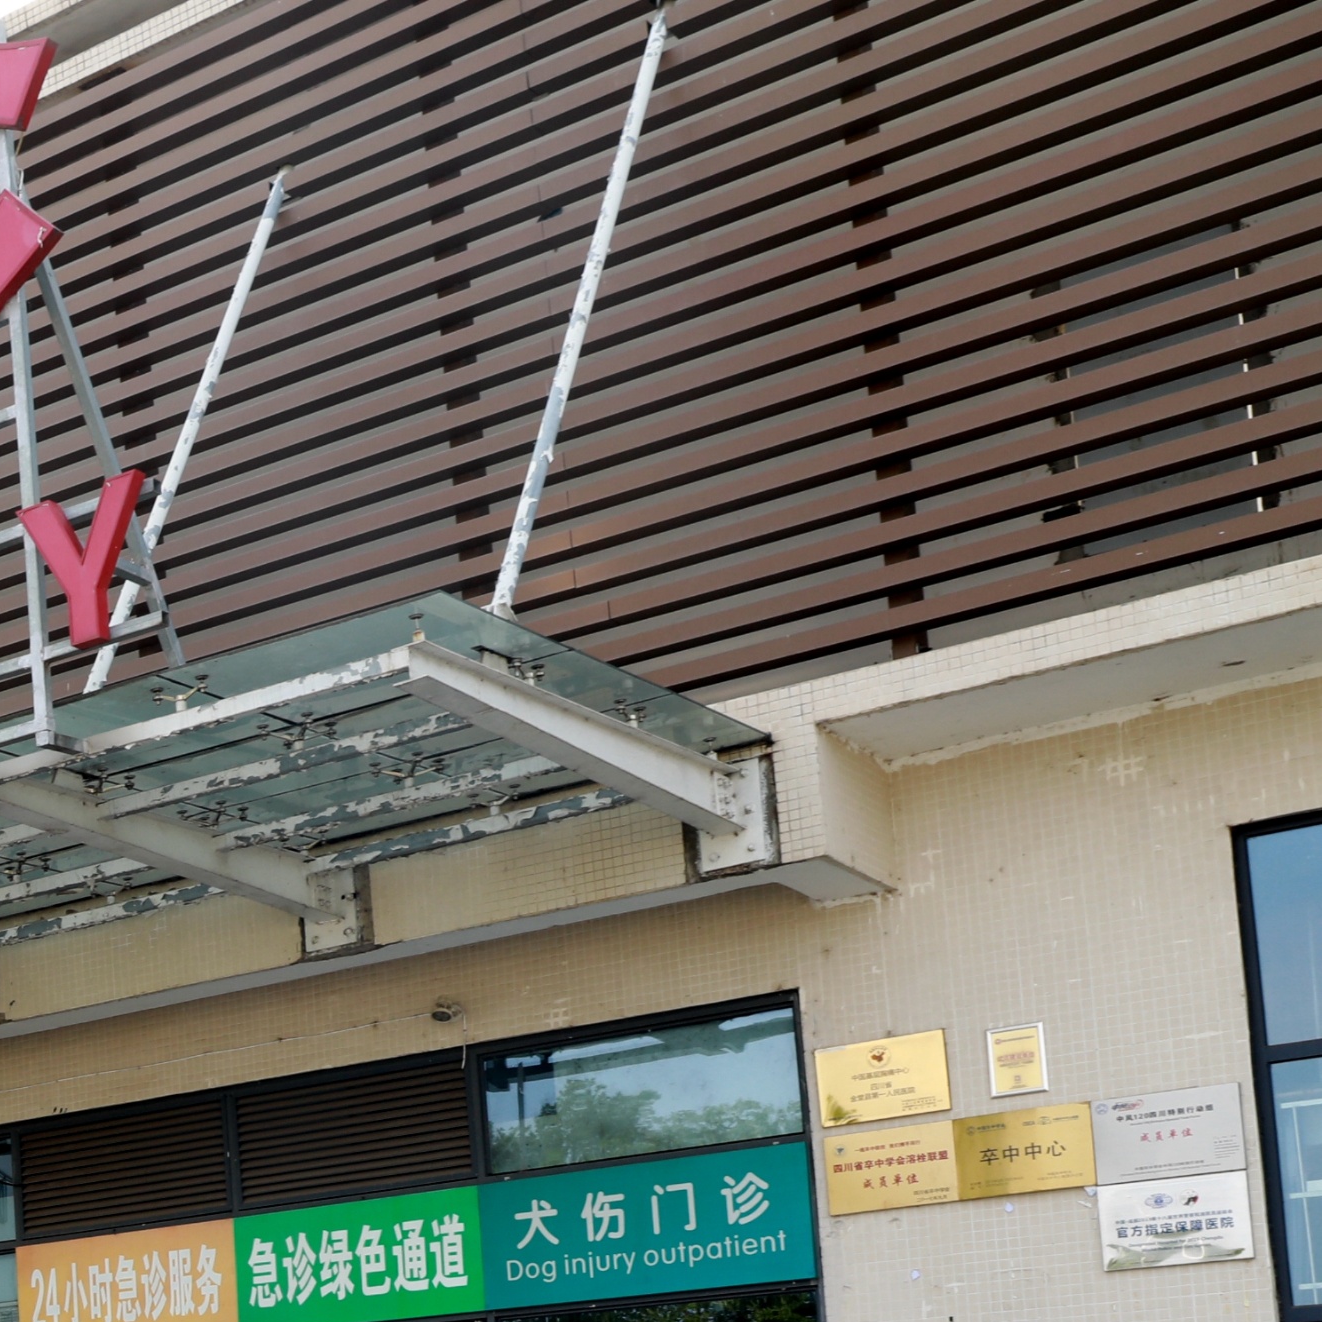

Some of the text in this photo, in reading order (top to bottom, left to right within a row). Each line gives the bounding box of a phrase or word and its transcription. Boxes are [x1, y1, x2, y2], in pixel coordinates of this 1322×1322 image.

[833, 1150, 949, 1173] 四川省卒中学会溶栓联盟
[979, 1140, 1066, 1166] 卒中中心
[863, 1173, 919, 1190] 成员单位
[515, 1171, 771, 1251] 犬伤门诊
[1116, 1217, 1235, 1239] 官方指定保障医院
[247, 1214, 468, 1310] 急诊绿色通道
[505, 1229, 787, 1286] Dog injury outpatient
